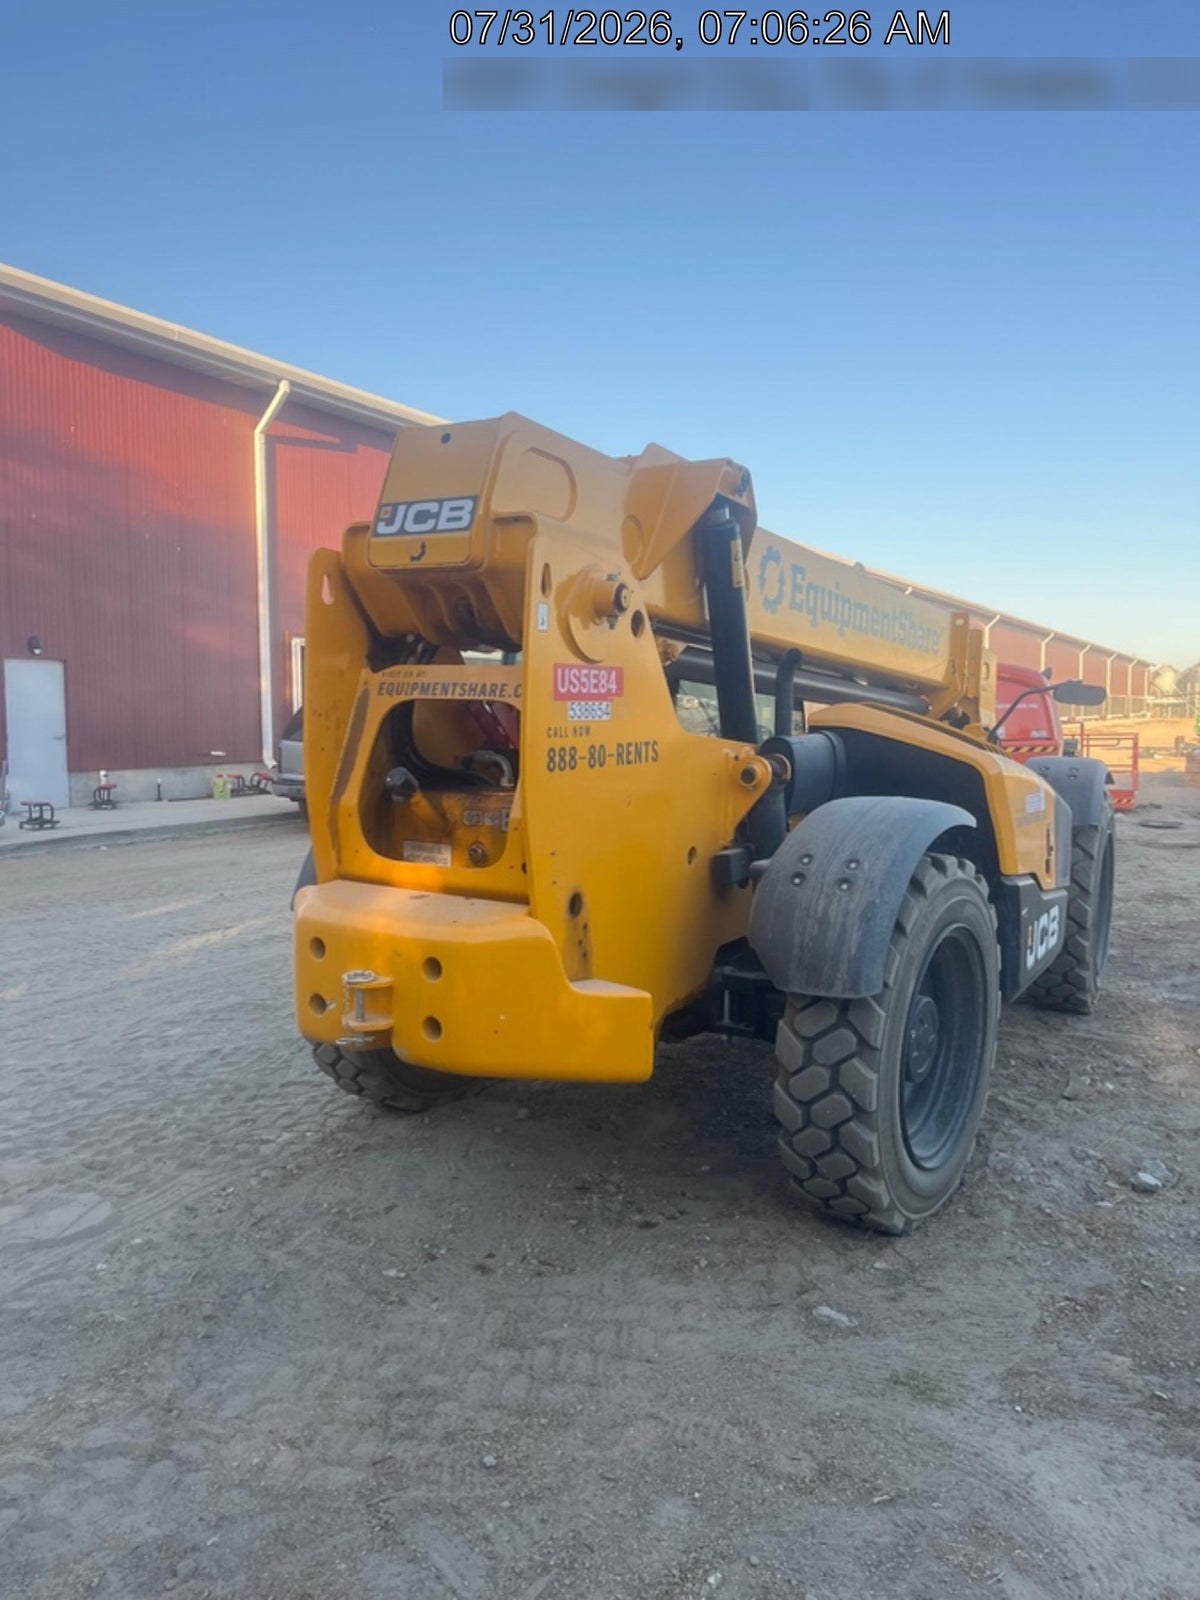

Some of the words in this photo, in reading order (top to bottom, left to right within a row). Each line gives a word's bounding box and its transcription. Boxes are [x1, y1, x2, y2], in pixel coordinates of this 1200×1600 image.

[376, 499, 475, 535] JCB
[789, 562, 945, 657] EquipmentShare
[556, 667, 617, 695] US5E84
[547, 725, 569, 739] CALL
[572, 724, 591, 737] NOW
[547, 740, 660, 773] 888-80-RENTS
[1026, 904, 1060, 970] JCB
